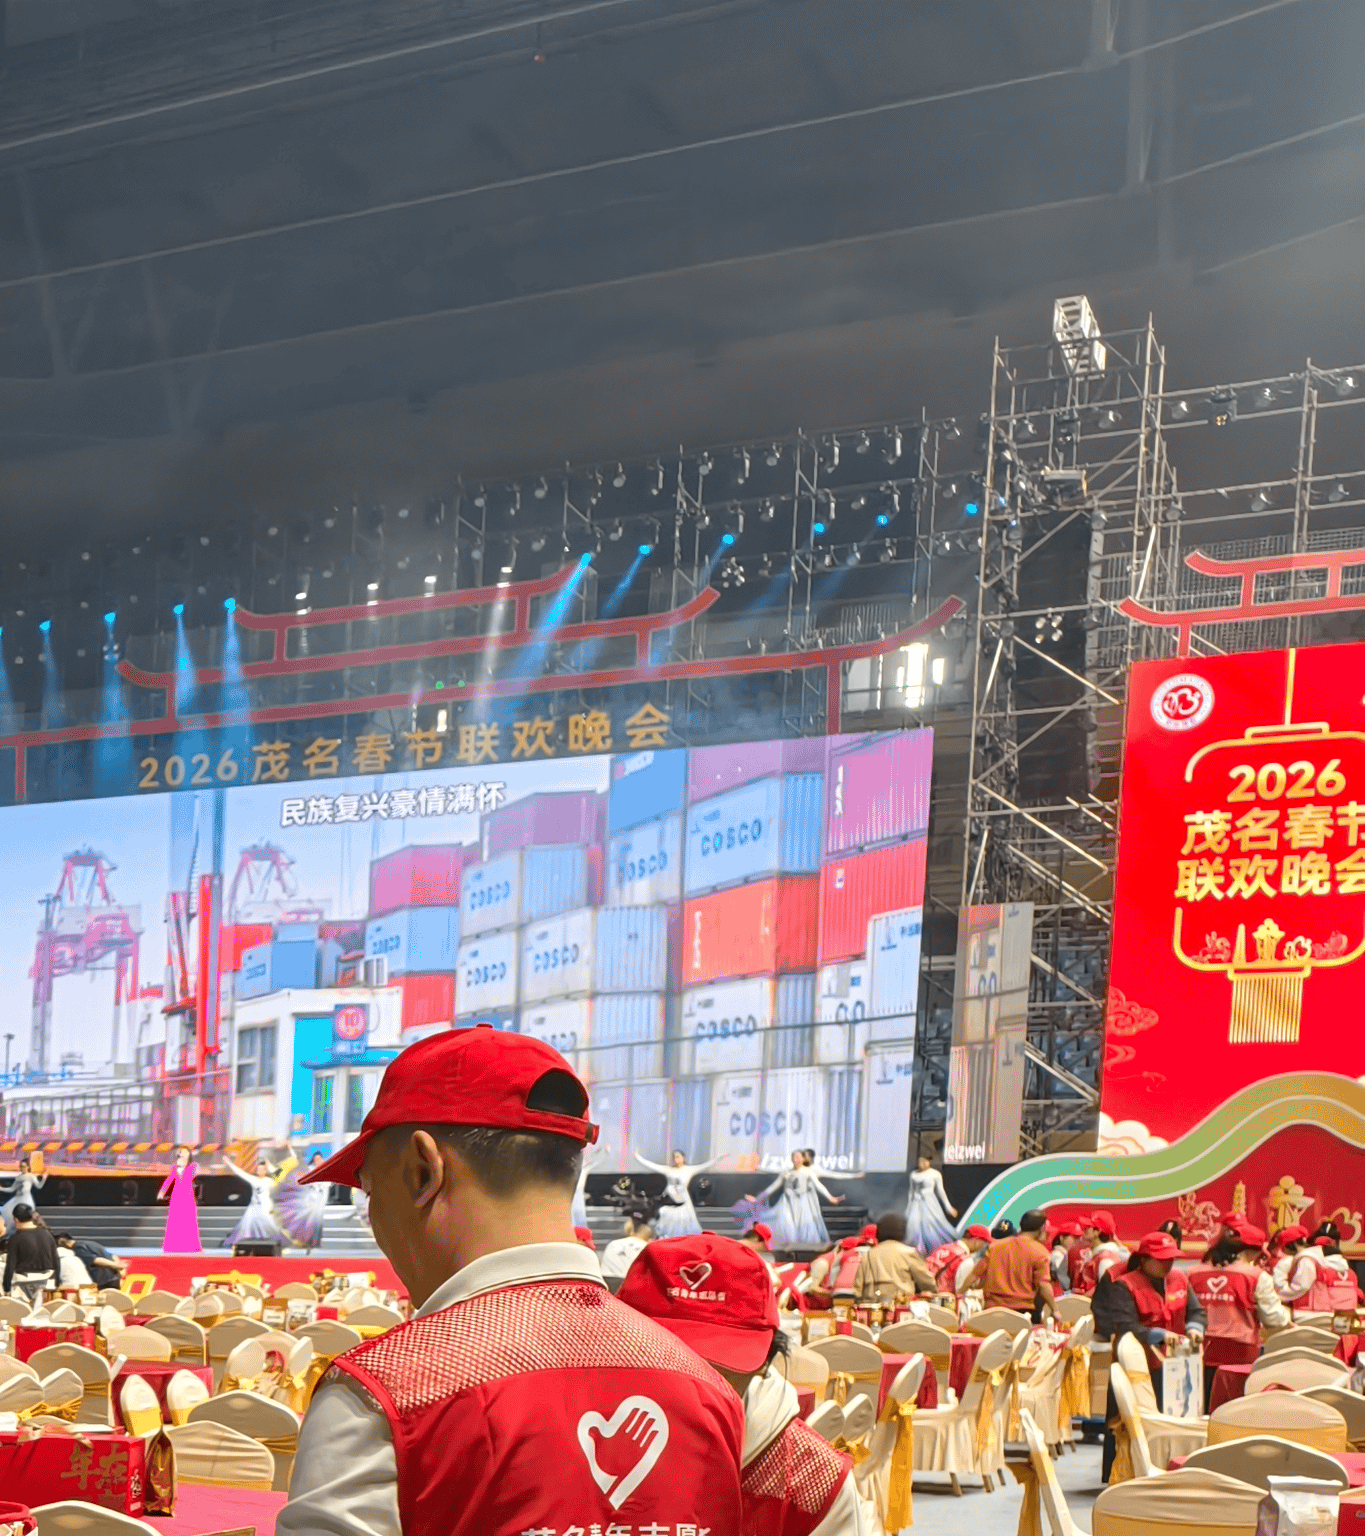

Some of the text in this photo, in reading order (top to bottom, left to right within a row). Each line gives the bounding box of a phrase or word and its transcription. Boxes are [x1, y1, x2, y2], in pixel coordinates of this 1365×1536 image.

[280, 780, 506, 827] 民族复兴豪情满怀
[1227, 758, 1346, 803] 2026
